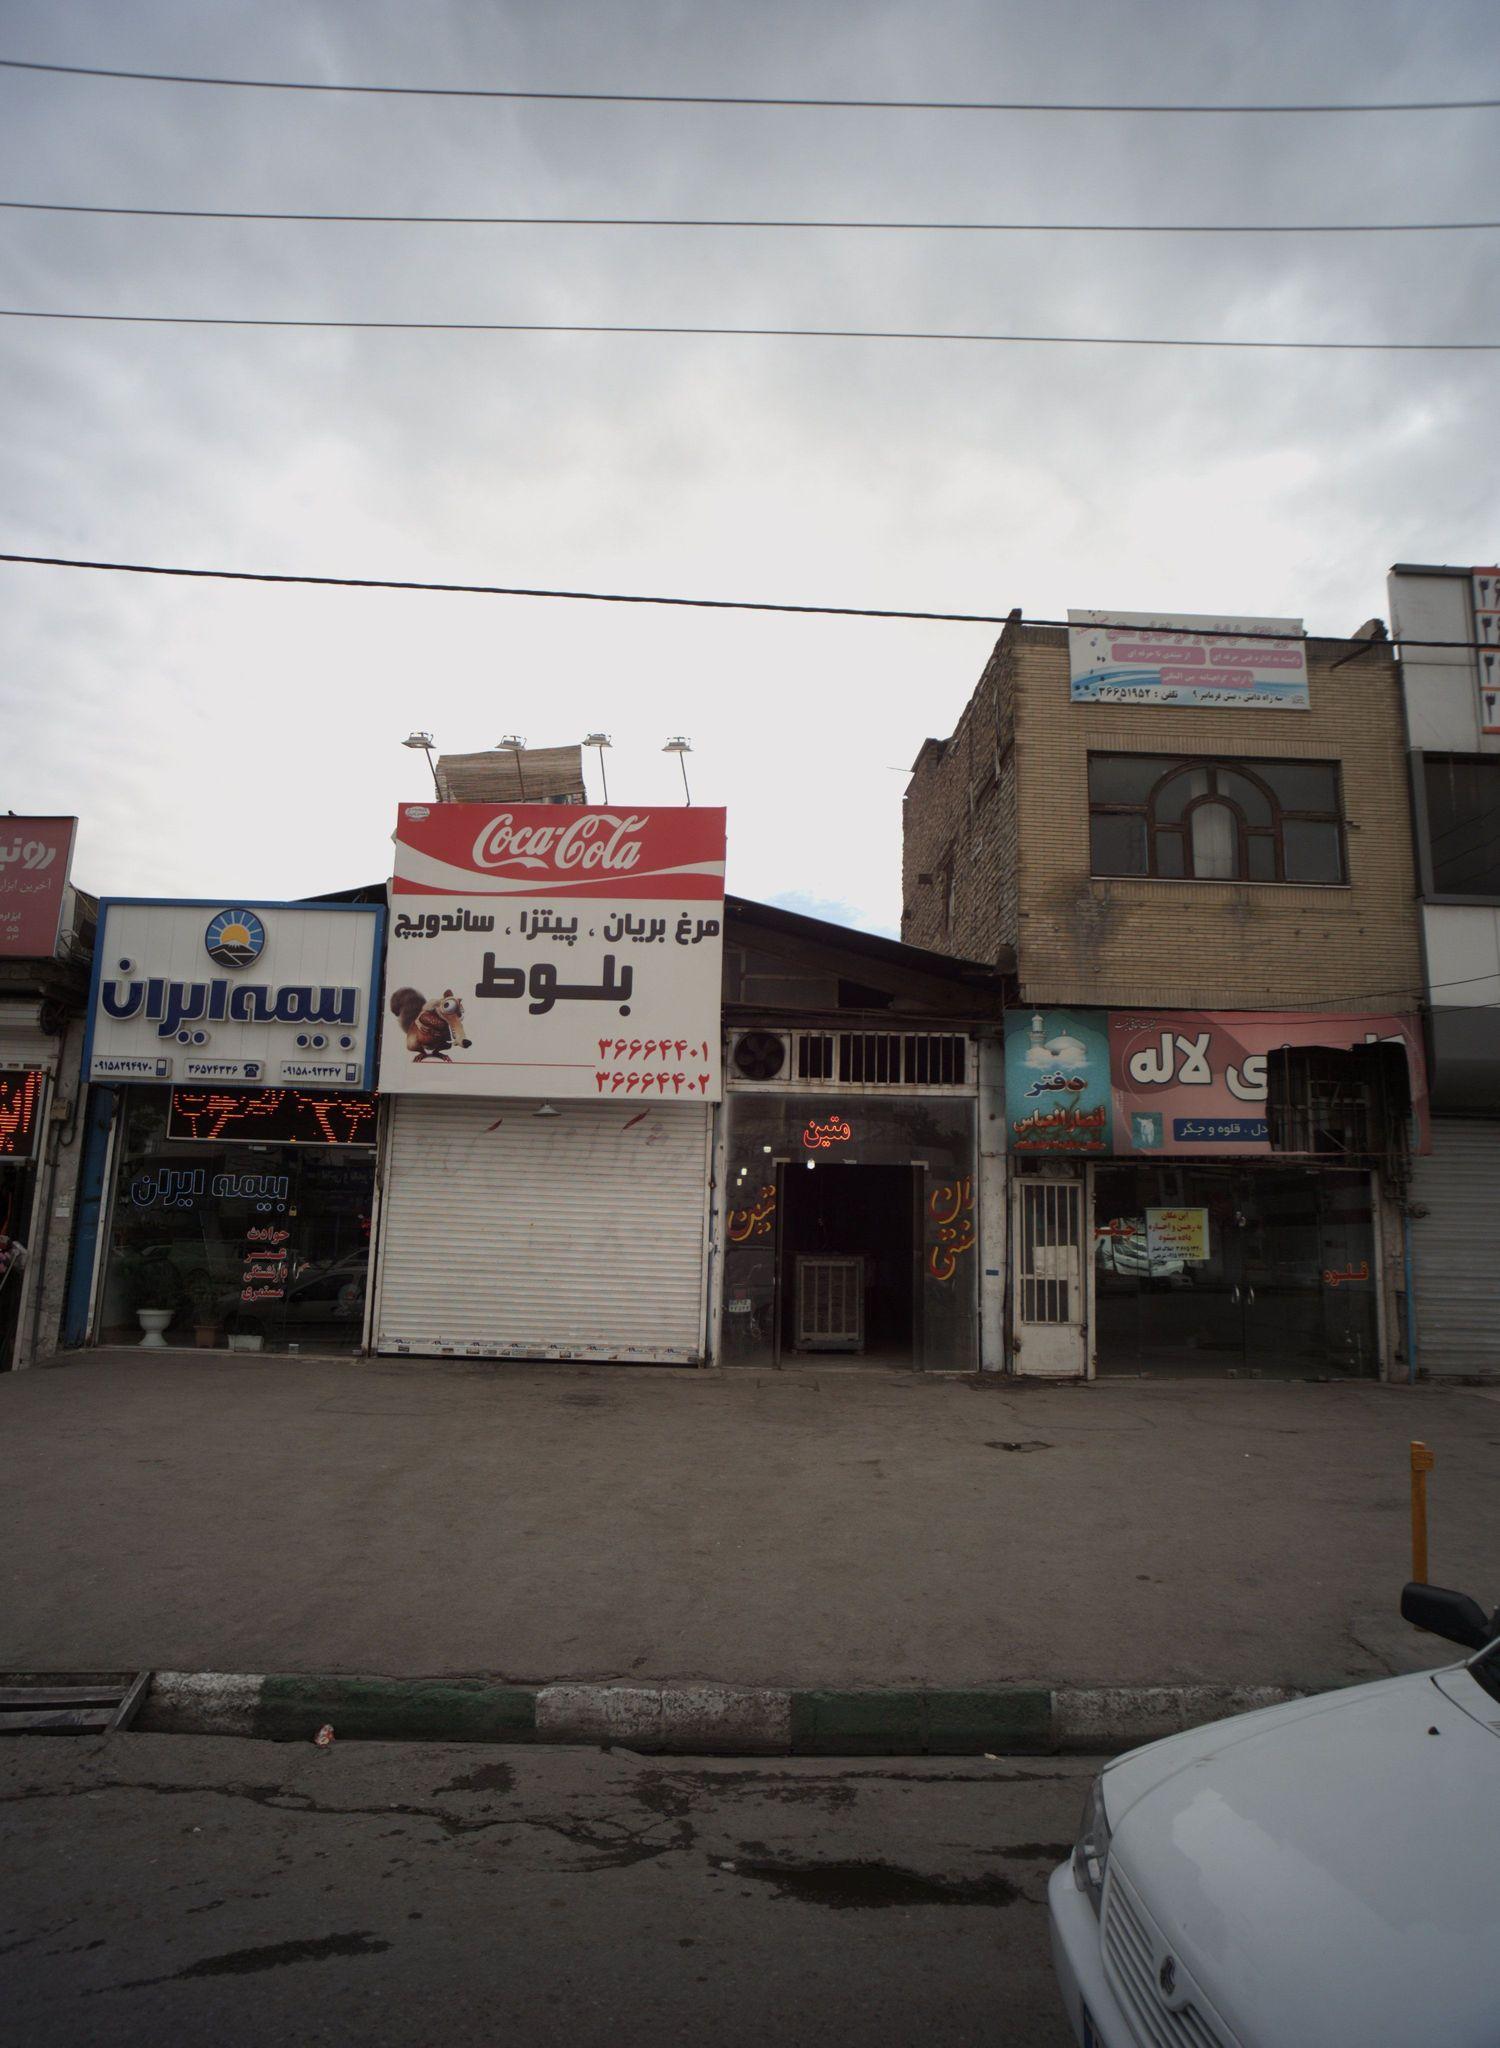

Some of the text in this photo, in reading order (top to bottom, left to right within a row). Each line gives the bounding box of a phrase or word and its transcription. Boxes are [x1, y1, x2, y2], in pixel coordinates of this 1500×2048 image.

[472, 813, 650, 869] Coca-Cola
[394, 907, 495, 939] ساندویچ
[519, 909, 578, 947] پیتزا
[603, 912, 666, 944] بریان
[675, 911, 720, 946] مرغ
[475, 952, 633, 1017] بلوط
[102, 957, 360, 1049] بیمه ایران
[598, 1038, 708, 1062] ۳۶۶۶۴۴۰۱
[1129, 1032, 1213, 1085] لاله
[595, 1071, 710, 1095] ۳۶۶۶۴۴۰۲
[1024, 1071, 1088, 1097] دفتر
[803, 1115, 851, 1148] متین
[1208, 1126, 1215, 1137] و
[1217, 1122, 1241, 1137] قلوه
[131, 1169, 288, 1212] بیمه ایران
[247, 1226, 290, 1244] حوادث
[243, 1247, 287, 1264] عمر
